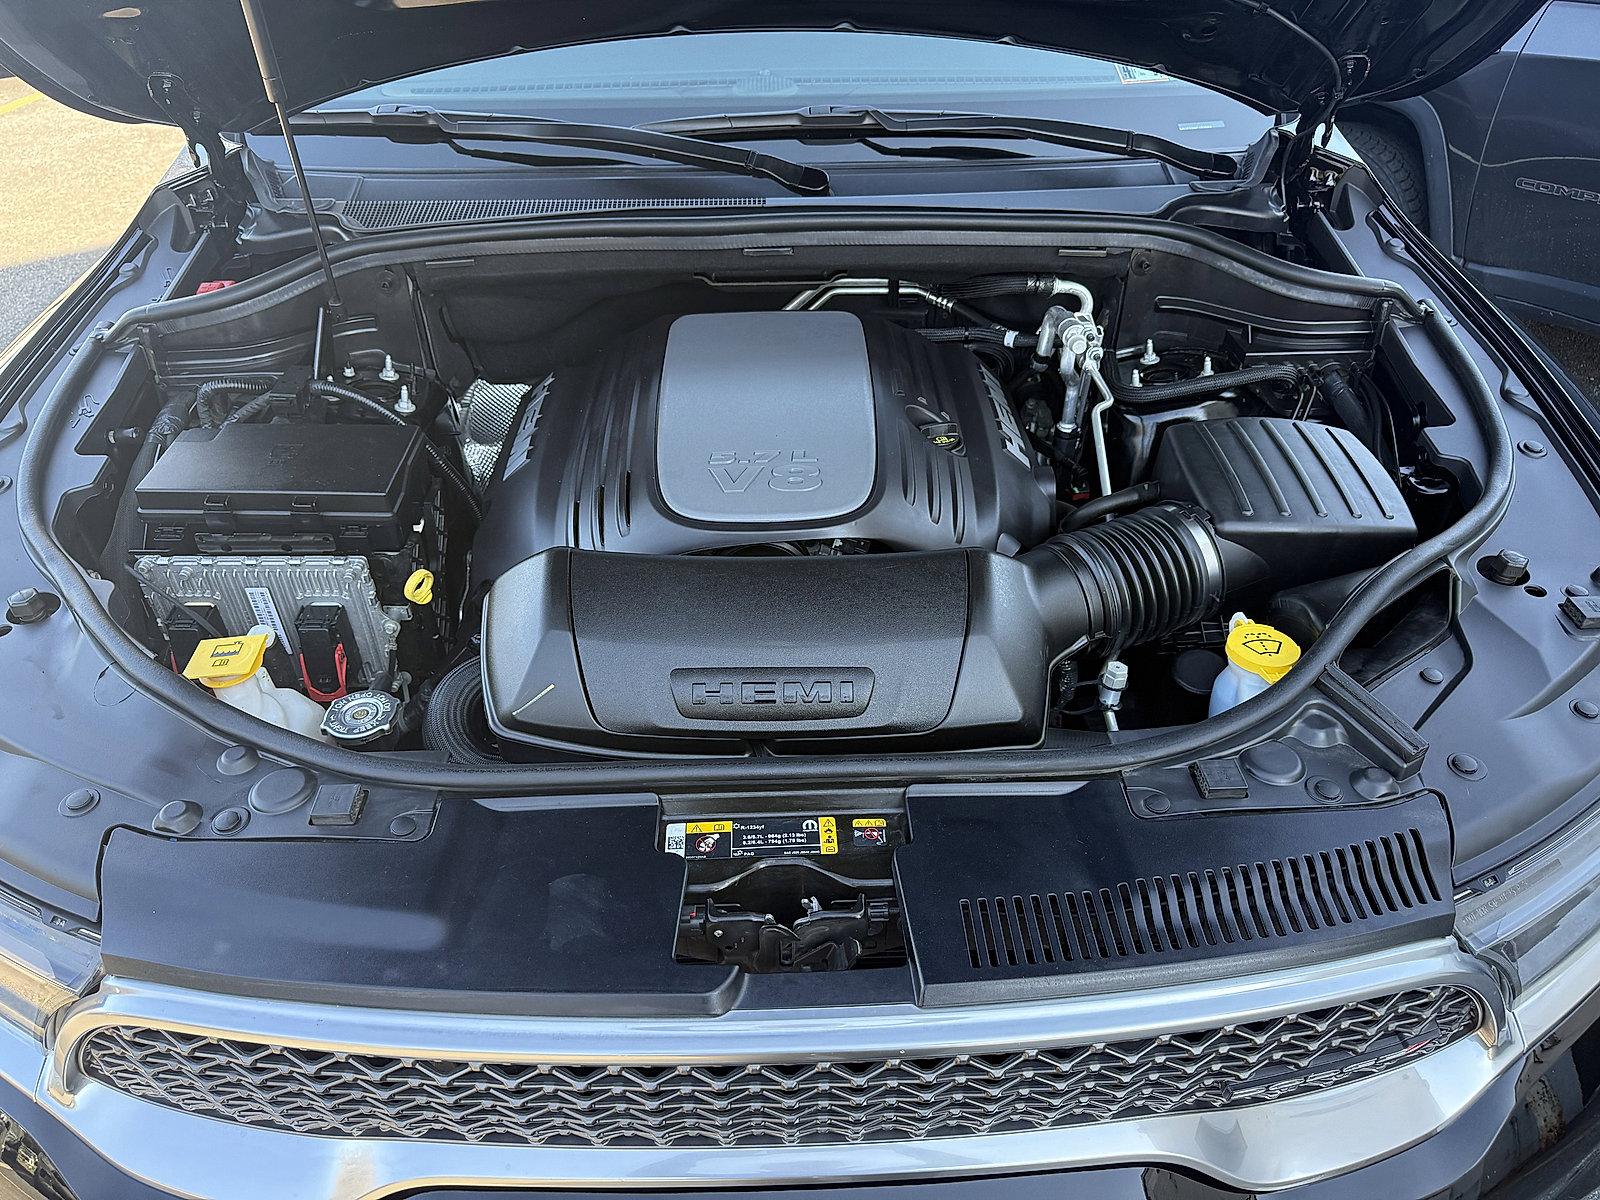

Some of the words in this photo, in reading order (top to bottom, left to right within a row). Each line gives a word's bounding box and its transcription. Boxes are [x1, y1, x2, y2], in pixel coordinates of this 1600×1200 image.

[1515, 177, 1600, 205] COMP
[707, 465, 824, 494] V8
[691, 680, 854, 705] HEMI
